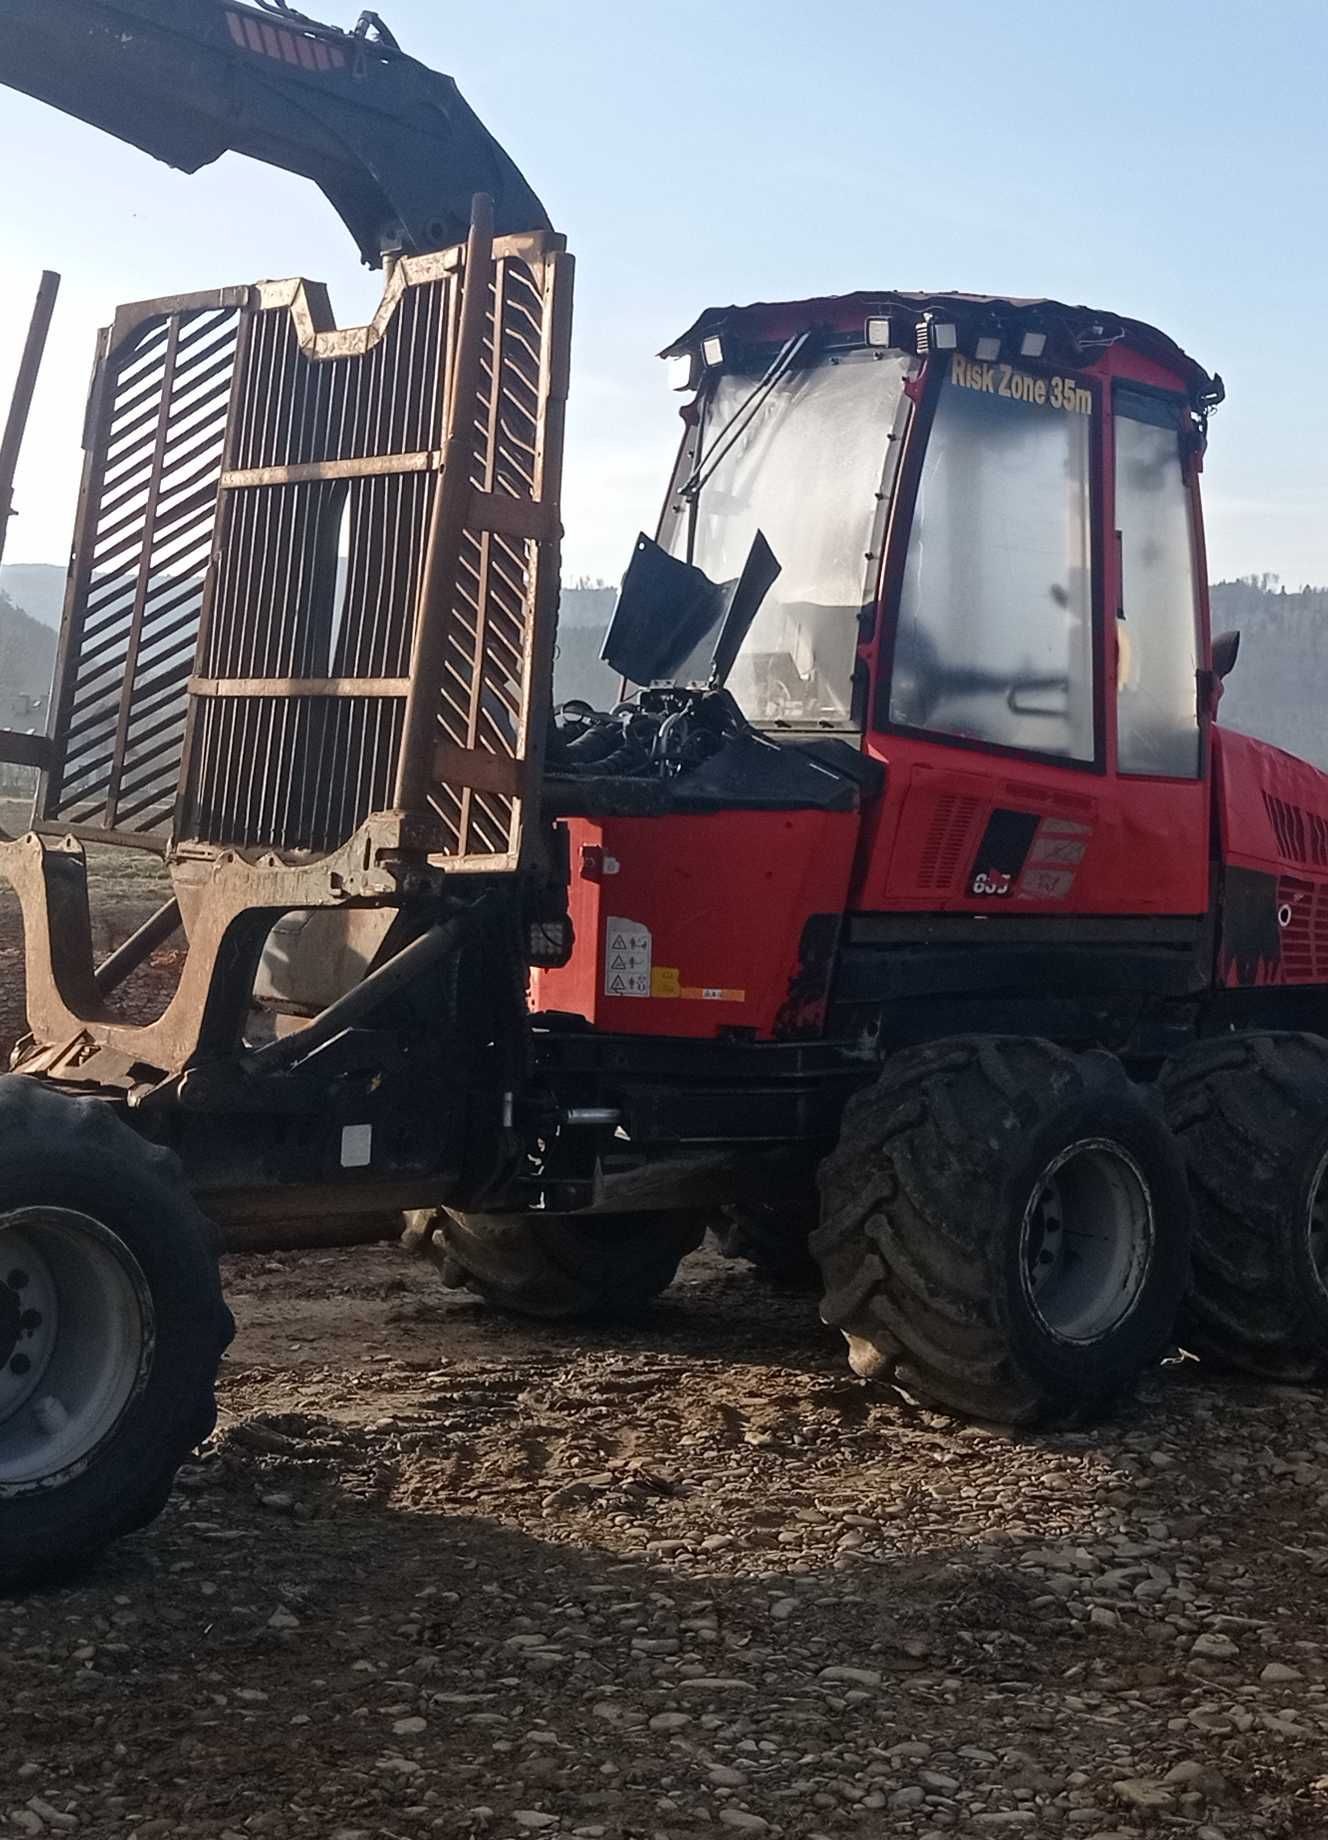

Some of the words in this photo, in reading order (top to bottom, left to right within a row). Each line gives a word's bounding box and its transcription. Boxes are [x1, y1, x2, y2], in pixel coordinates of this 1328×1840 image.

[952, 356, 994, 392] Risk
[999, 365, 1046, 404] Zone
[1051, 377, 1092, 414] 35m
